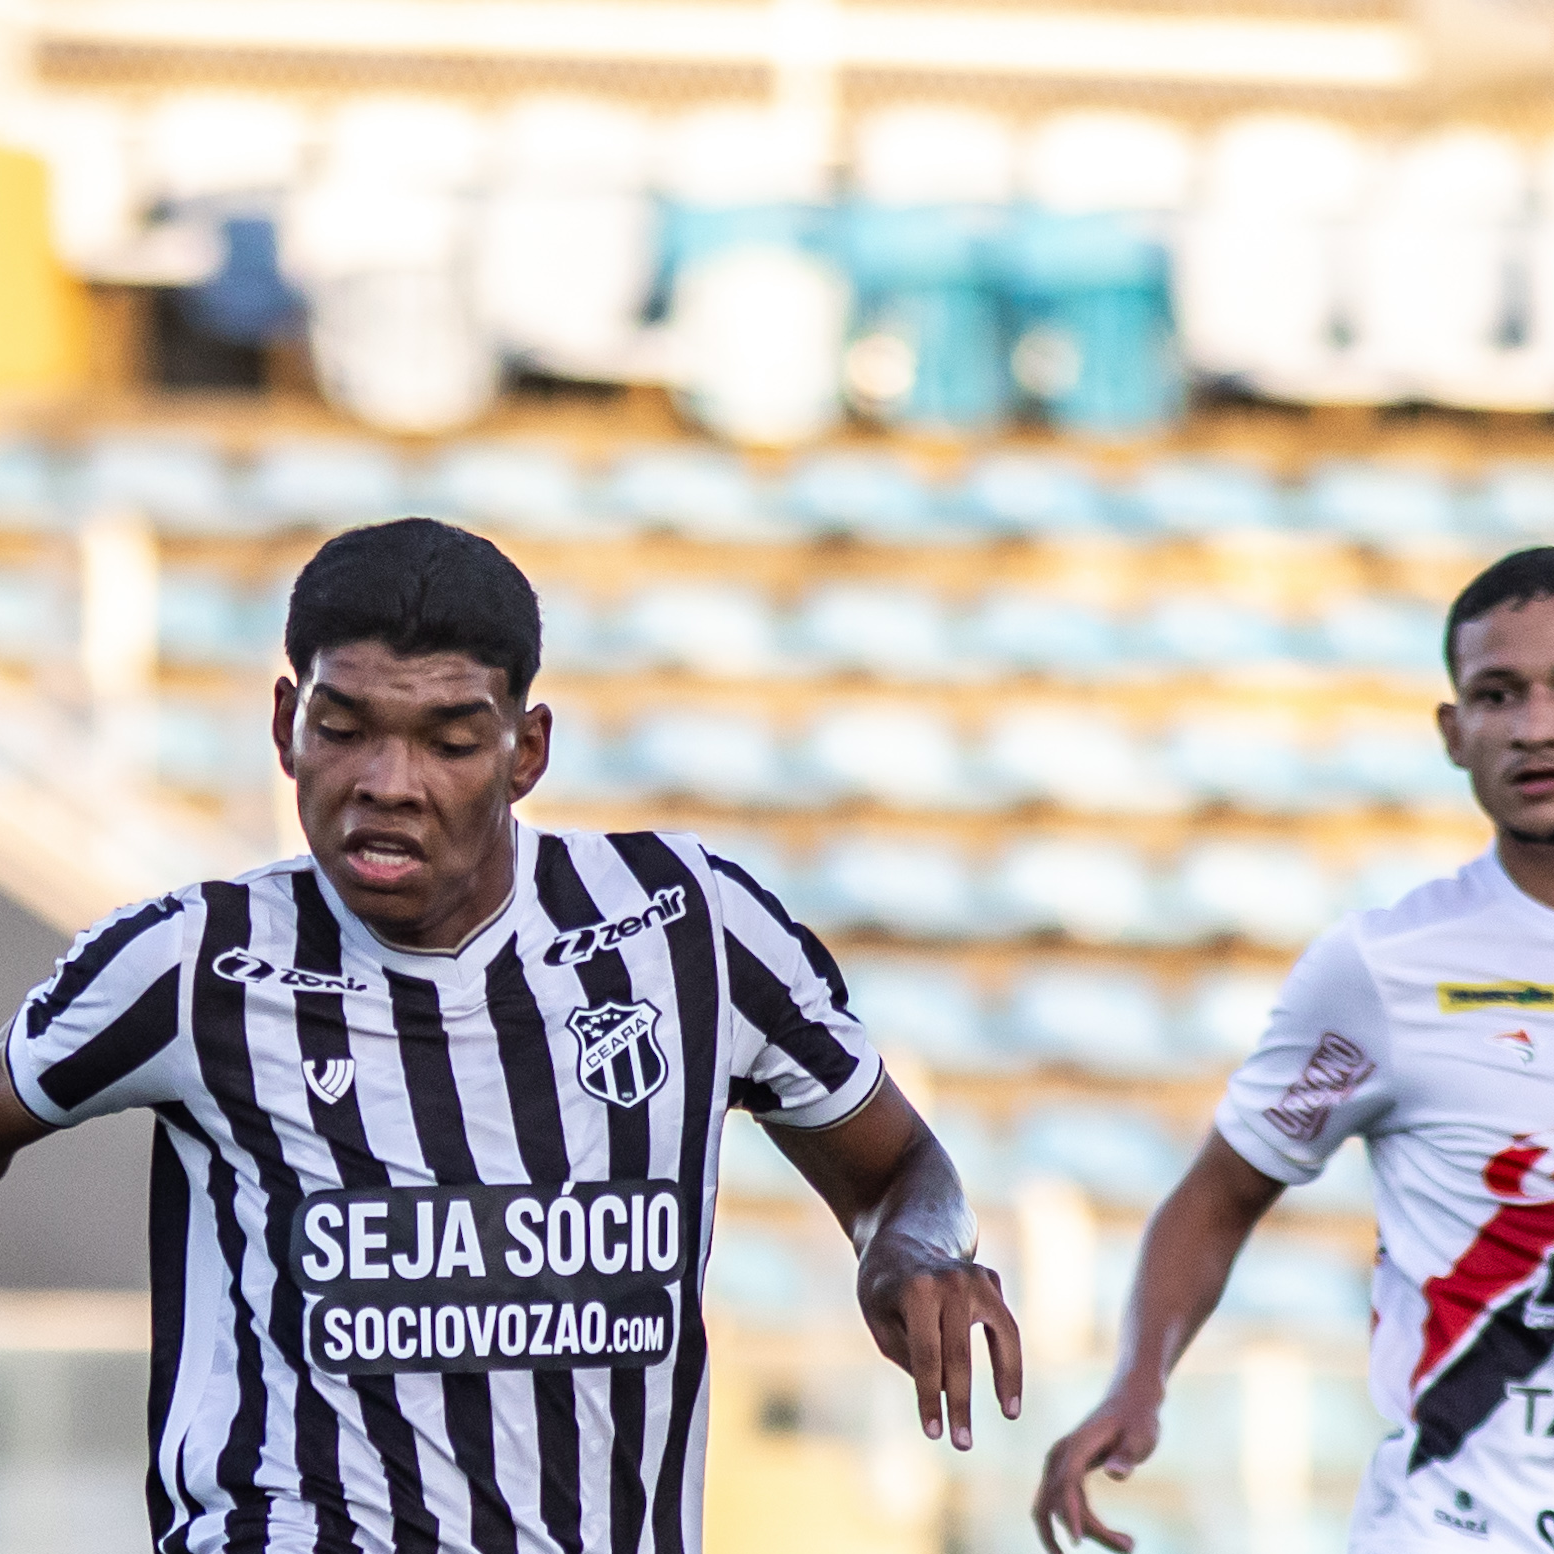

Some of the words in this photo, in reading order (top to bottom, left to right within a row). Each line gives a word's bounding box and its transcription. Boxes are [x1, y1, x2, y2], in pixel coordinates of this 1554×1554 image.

[599, 890, 683, 947] zenir
[302, 1200, 486, 1282] SEJA
[504, 1181, 680, 1278] SÓCIO
